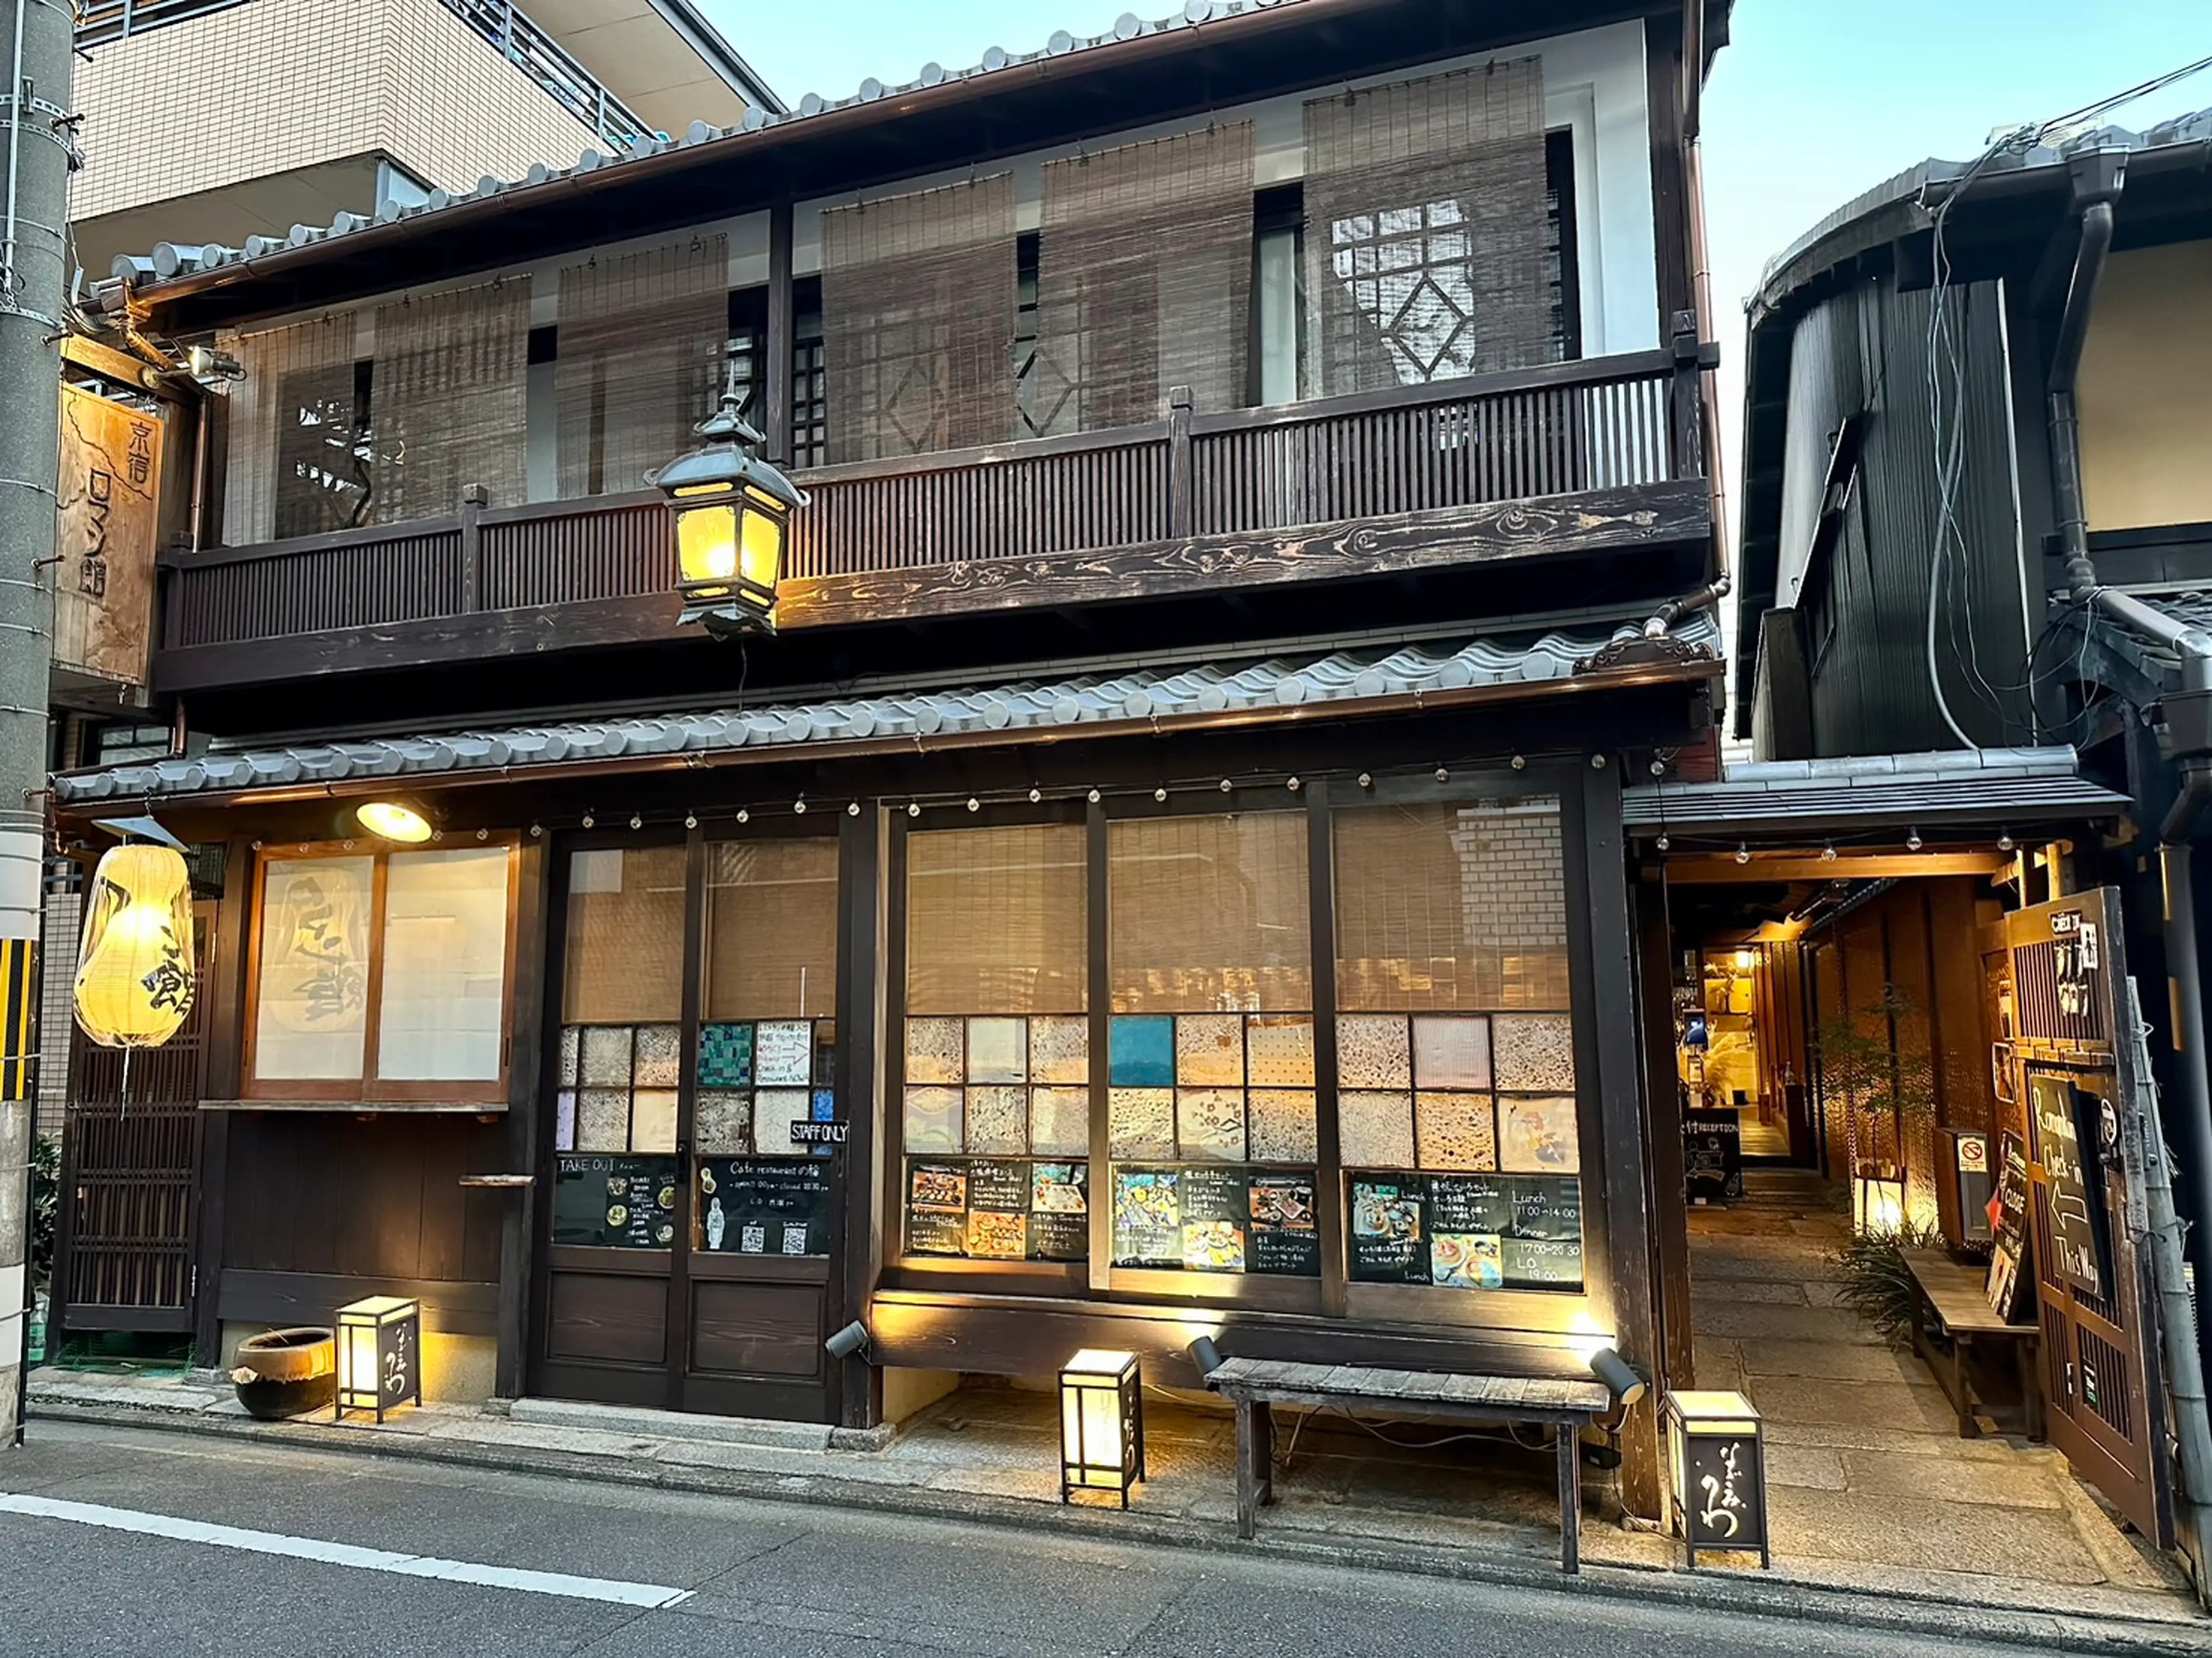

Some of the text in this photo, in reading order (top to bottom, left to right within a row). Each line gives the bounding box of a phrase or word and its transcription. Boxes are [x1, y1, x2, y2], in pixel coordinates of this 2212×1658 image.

[79, 468, 112, 597] ロマン館
[791, 1124, 849, 1142] STAFF ONLY
[1699, 1122, 1738, 1133] RECEPTION
[560, 1159, 589, 1171] TAKE
[592, 1158, 616, 1171] OUT
[730, 1161, 753, 1174] Cafe
[1512, 1190, 1547, 1204] Lunch
[2054, 1235, 2081, 1276] This
[2078, 1244, 2099, 1294] Way
